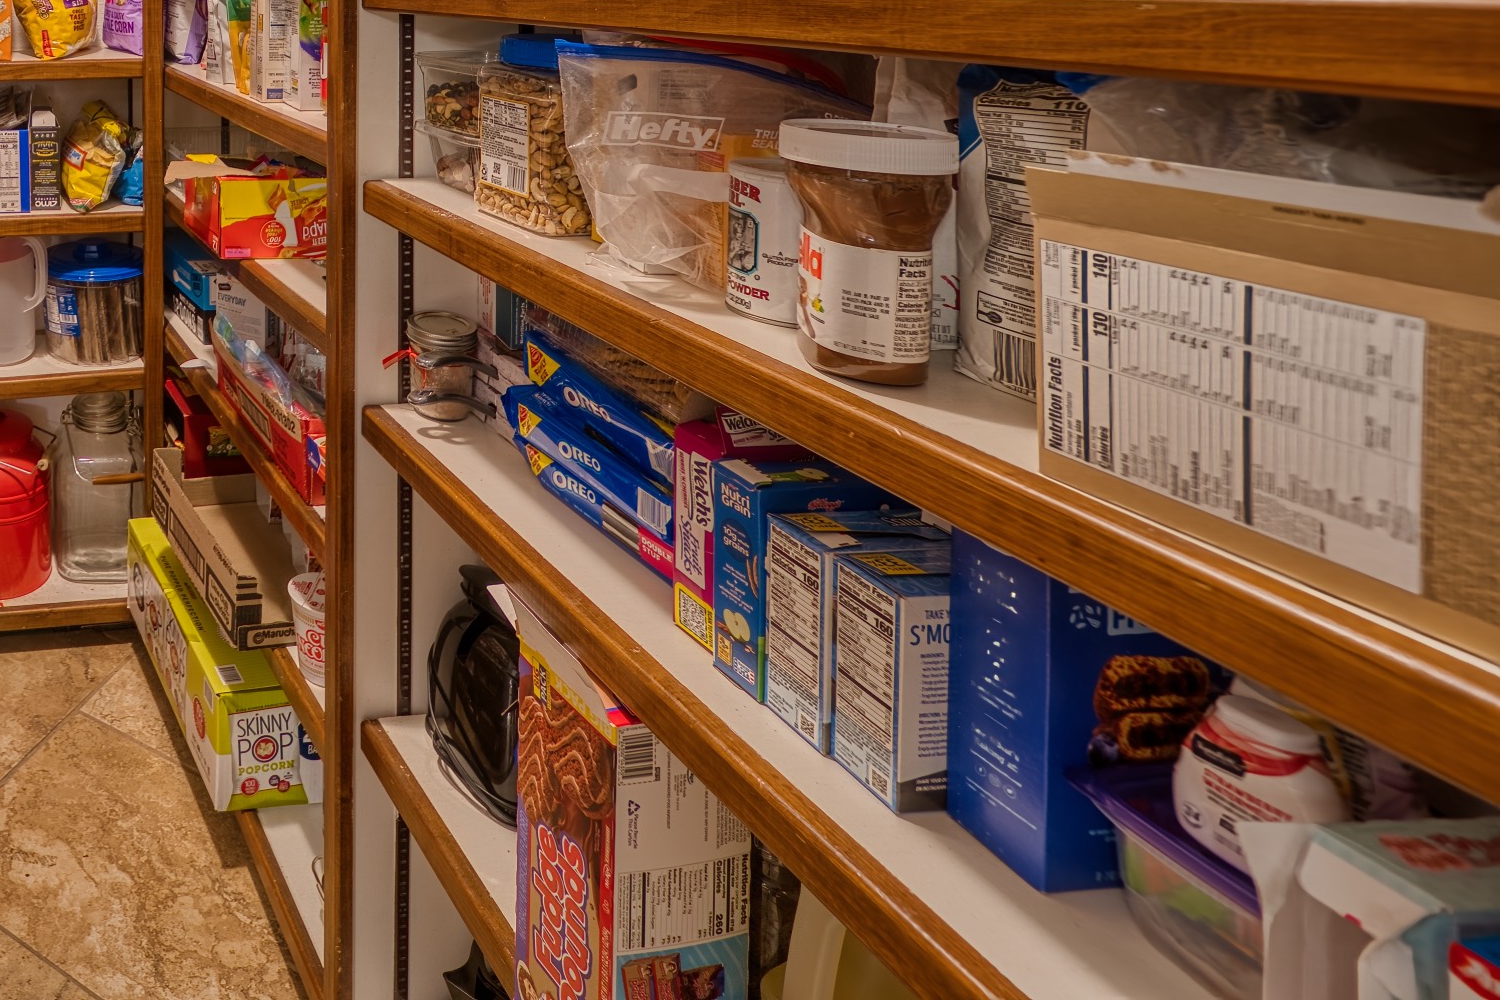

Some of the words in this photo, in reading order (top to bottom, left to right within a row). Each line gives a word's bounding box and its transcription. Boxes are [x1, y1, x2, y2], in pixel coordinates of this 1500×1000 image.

[115, 20, 134, 34] CORN
[610, 115, 716, 149] Hefty
[756, 128, 779, 139] TRU
[767, 259, 794, 268] PRODUCT
[899, 268, 926, 278] Facts
[1092, 253, 1108, 278] 140
[218, 292, 246, 307] EVERYDAY
[1092, 312, 1108, 337] 130
[1049, 356, 1062, 391] Facts
[563, 387, 611, 421] OREO
[1048, 393, 1062, 451] Nutrition
[558, 441, 601, 472] OREO
[552, 470, 596, 504] OREO
[694, 461, 709, 528] Welch's
[721, 482, 750, 507] Nutri
[721, 494, 752, 519] Grain
[680, 514, 692, 576] Snacks
[723, 526, 737, 540] 10g
[723, 536, 750, 557] grains
[772, 525, 799, 549] Nutrition
[800, 544, 819, 562] Facts
[641, 536, 673, 563] DOUBLE
[642, 546, 661, 562] STUF
[692, 530, 703, 577] Fruit
[772, 554, 797, 576] Calories
[802, 572, 819, 590] 160
[839, 564, 870, 591] Nutrition
[872, 587, 894, 607] Facts
[839, 595, 868, 621] Calories
[874, 617, 893, 637] 160
[925, 610, 945, 619] TAKE
[540, 667, 548, 700] PACK
[237, 712, 292, 737] SKINNY
[238, 732, 293, 766] POP
[238, 760, 295, 776] POPCORN
[715, 860, 723, 894] Calories
[741, 854, 749, 894] Nutrition
[534, 825, 562, 984] Fudge
[740, 898, 748, 925] Facts
[715, 913, 723, 936] 260
